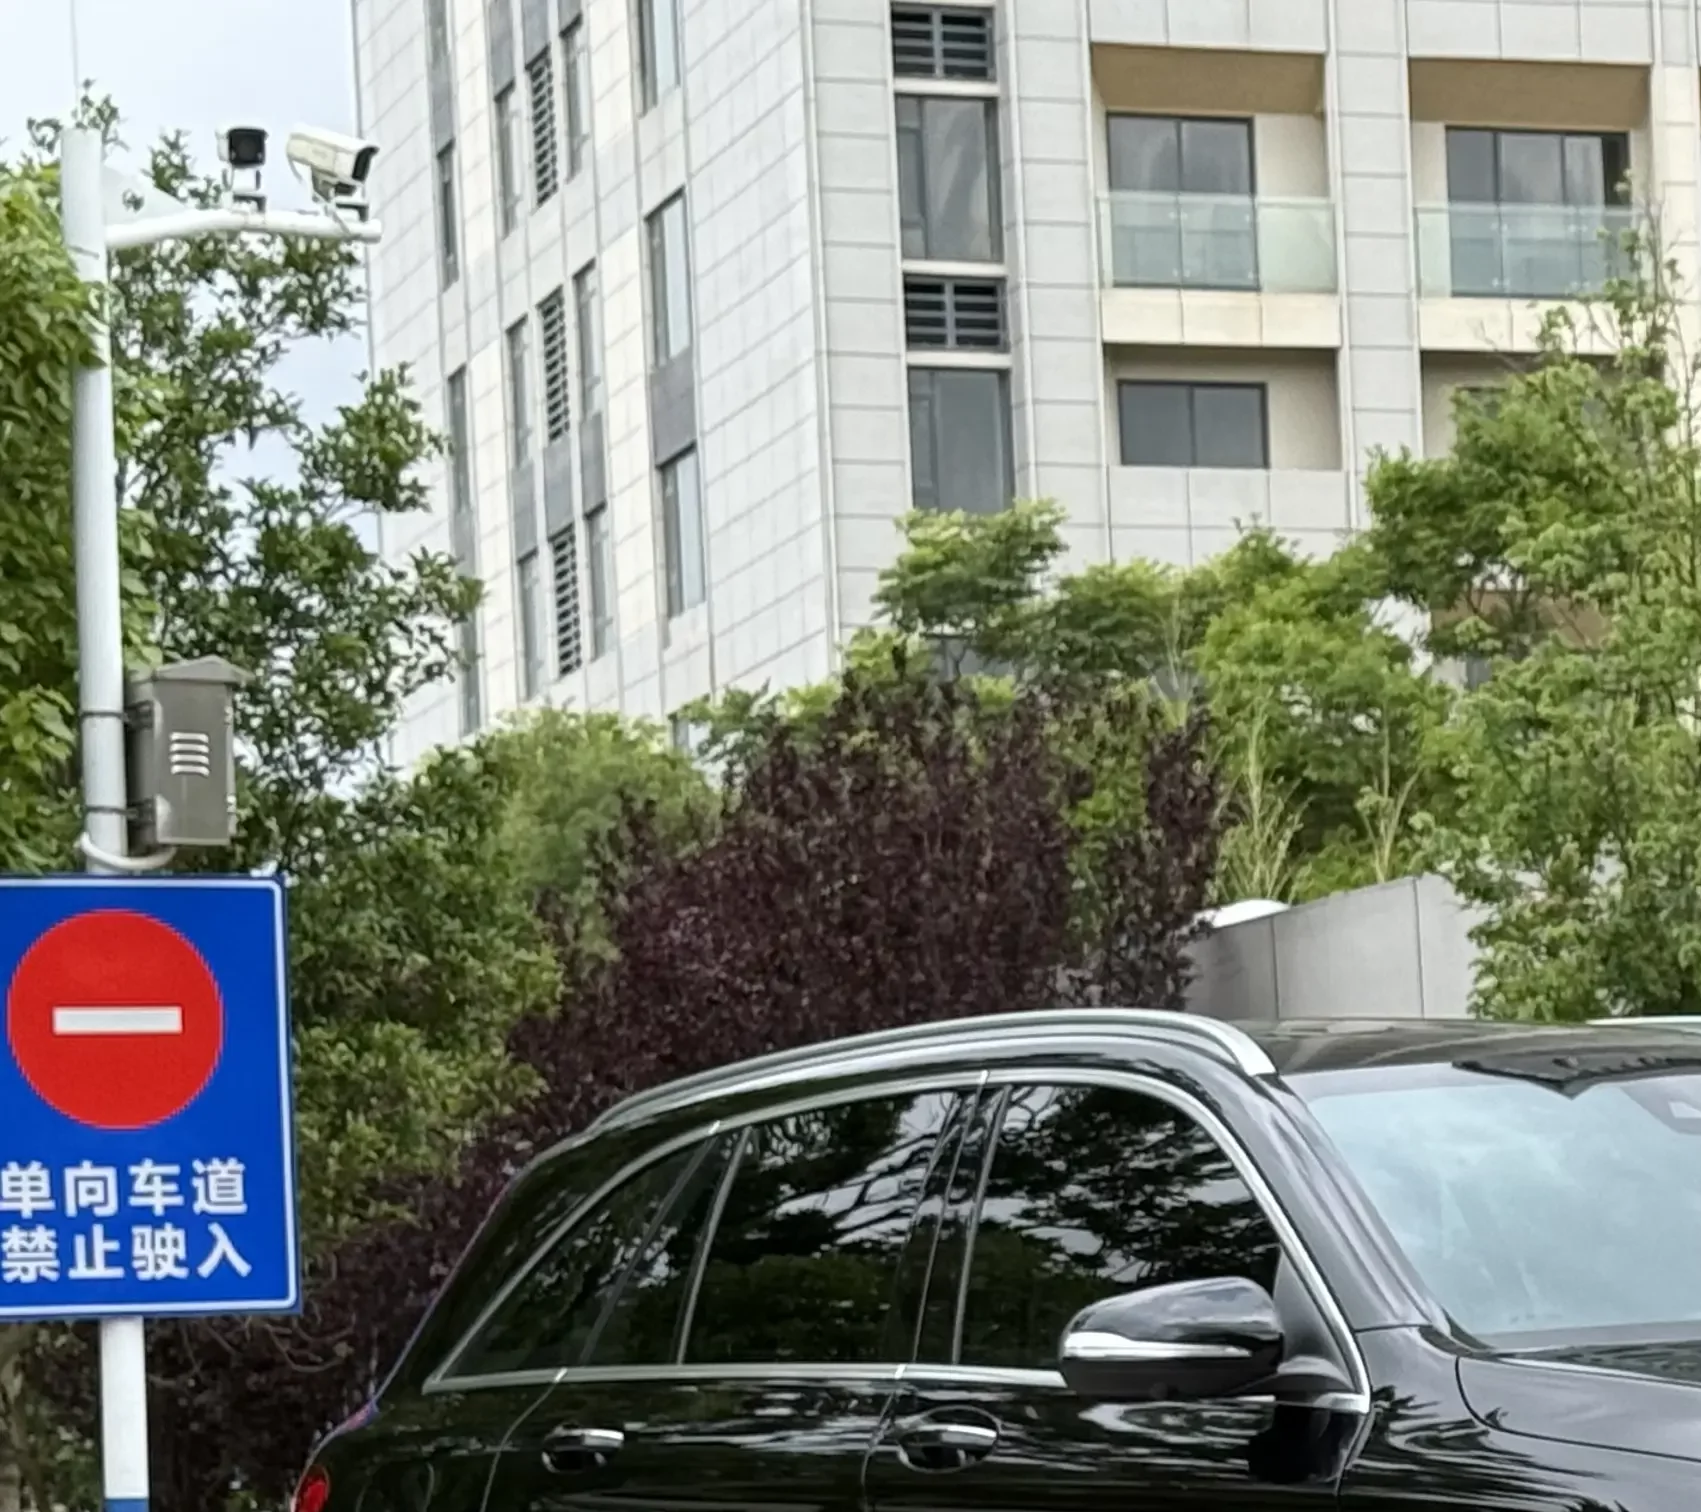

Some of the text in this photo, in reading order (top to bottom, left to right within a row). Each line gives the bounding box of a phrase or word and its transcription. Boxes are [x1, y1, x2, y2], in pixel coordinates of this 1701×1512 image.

[0, 1157, 248, 1219] 单向车道
[1, 1222, 253, 1284] 禁止驶入
